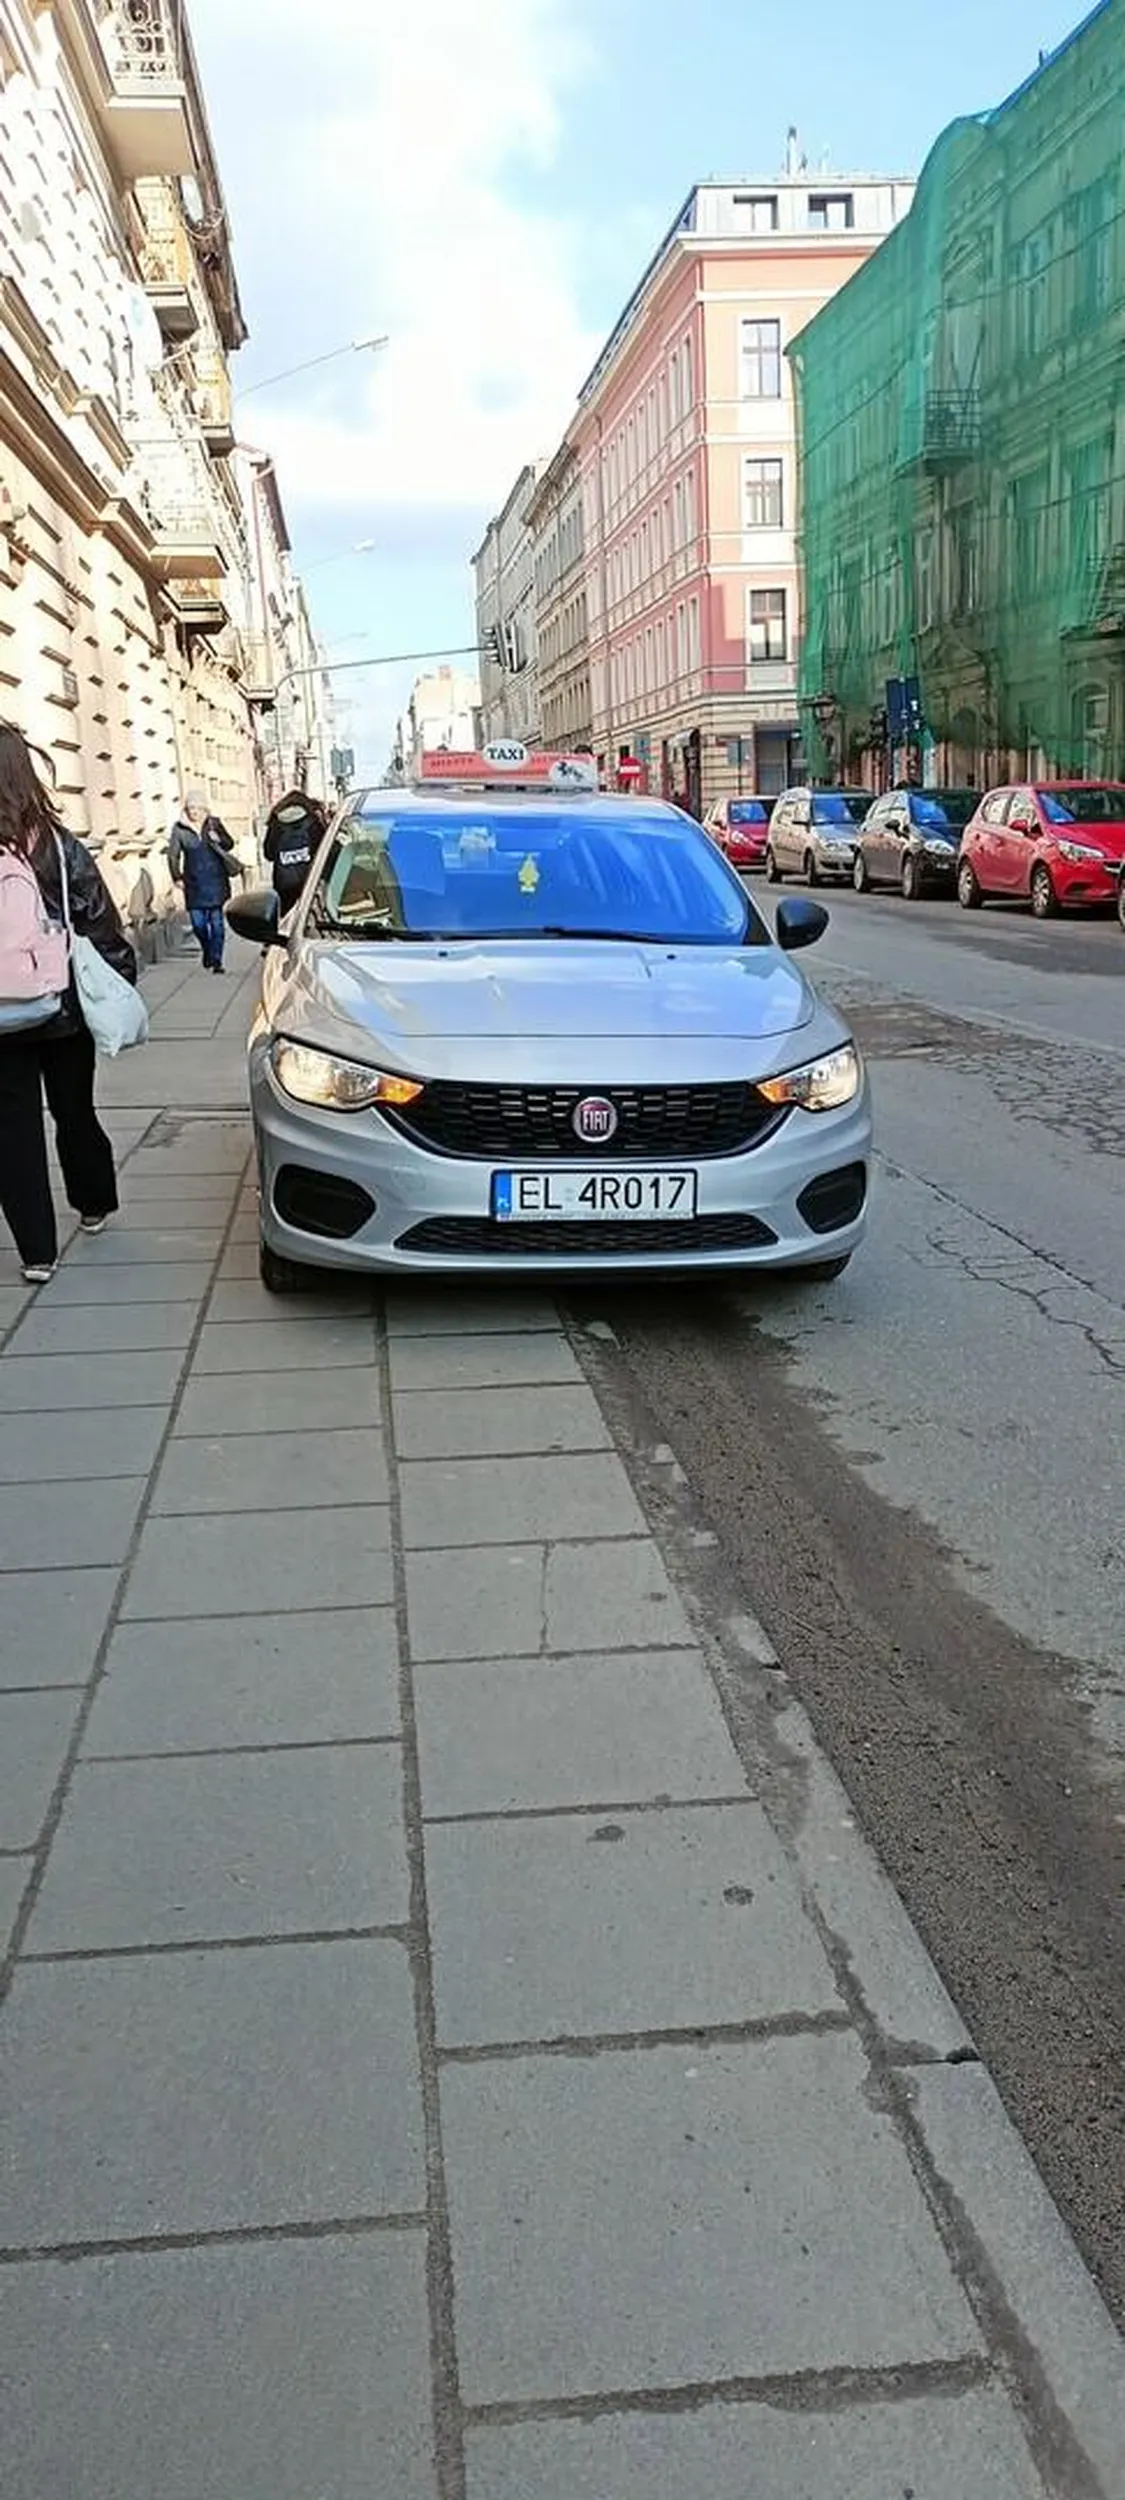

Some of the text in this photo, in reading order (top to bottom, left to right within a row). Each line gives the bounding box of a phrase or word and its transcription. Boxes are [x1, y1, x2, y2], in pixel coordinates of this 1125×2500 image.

[486, 748, 524, 761] TAXI
[279, 847, 311, 865] VANS
[583, 1110, 608, 1130] FIAT
[519, 1177, 686, 1210] EL 4R017
